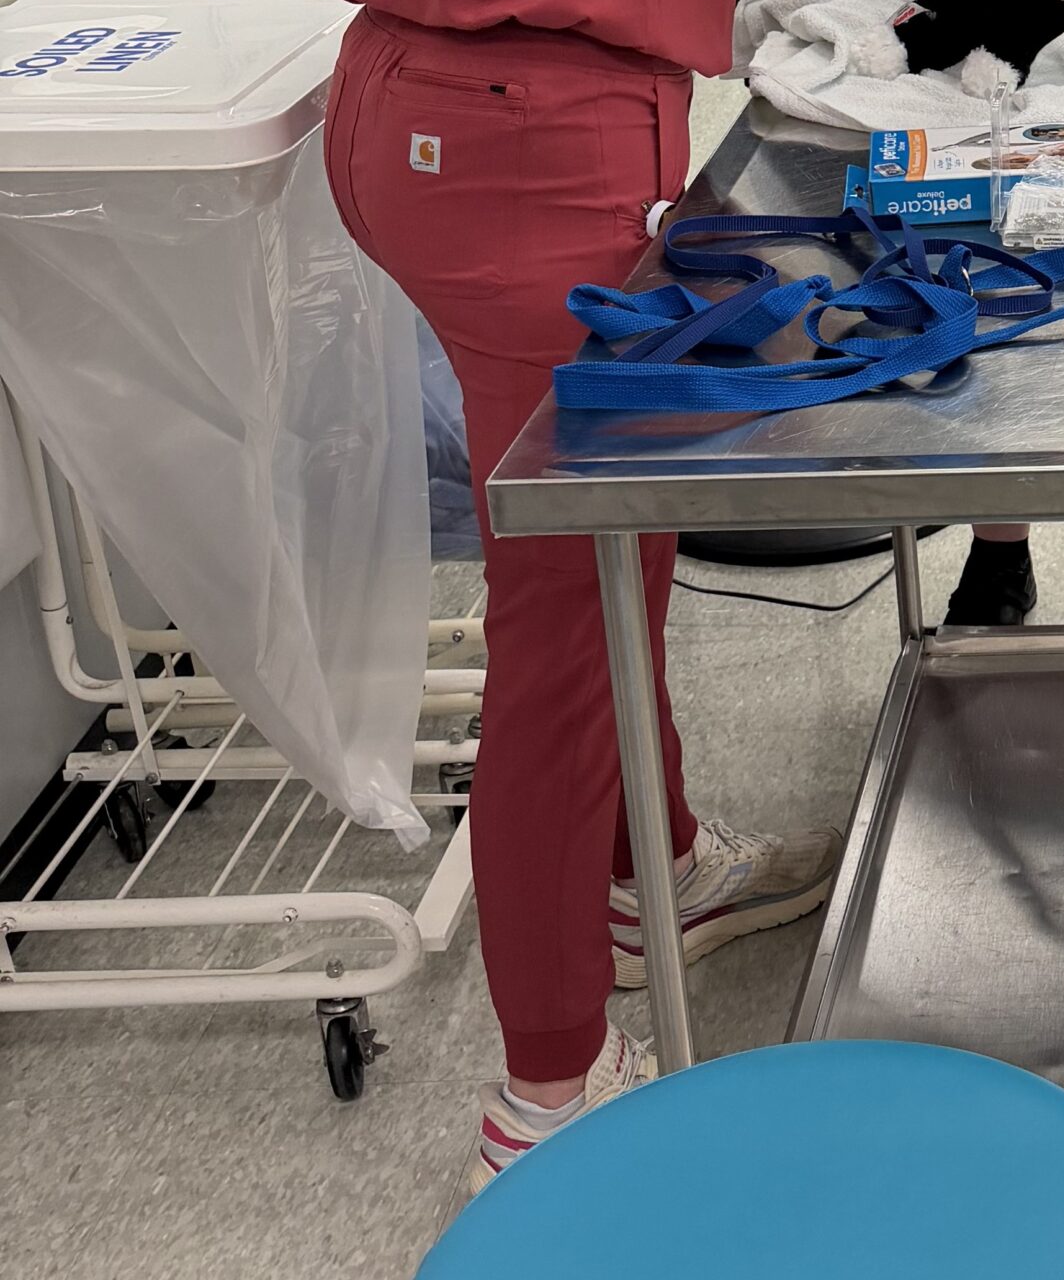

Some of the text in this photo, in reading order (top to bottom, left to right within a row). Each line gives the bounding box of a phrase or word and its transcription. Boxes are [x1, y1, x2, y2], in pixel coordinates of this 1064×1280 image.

[0, 27, 117, 77] SOILED
[75, 31, 183, 72] LINEN
[879, 132, 901, 160] peticare
[887, 193, 973, 216] peticare
[916, 191, 945, 199] Deluxe
